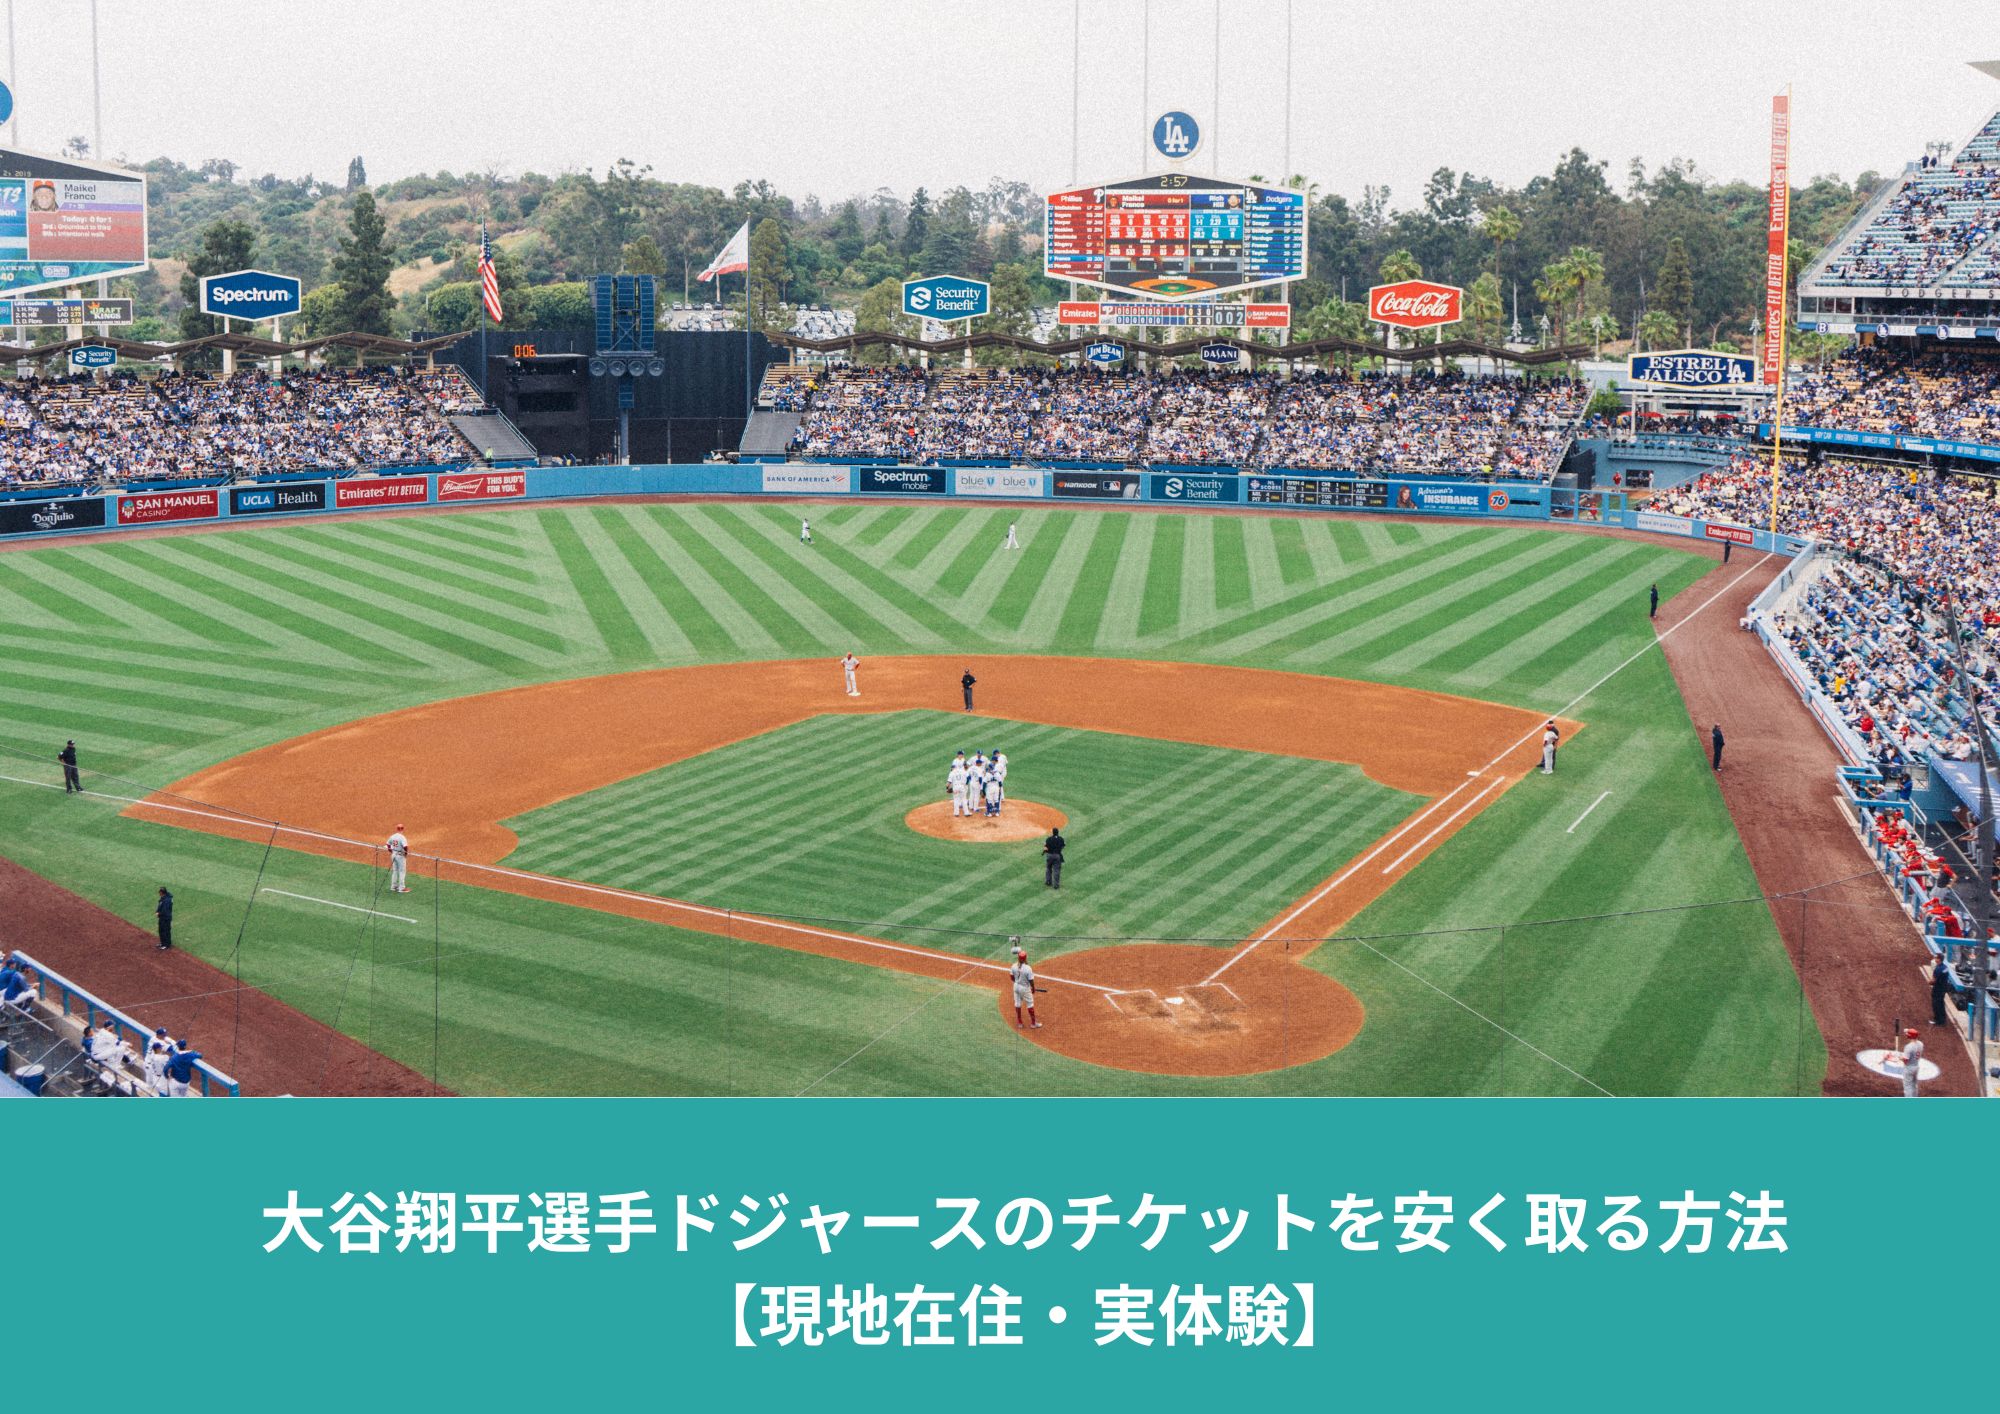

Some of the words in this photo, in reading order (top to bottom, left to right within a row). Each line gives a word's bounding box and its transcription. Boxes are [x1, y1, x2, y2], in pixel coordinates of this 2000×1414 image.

[1163, 116, 1188, 153] LA
[1773, 112, 1787, 145] BETTER
[1773, 146, 1786, 167] FLY
[1160, 176, 1188, 187] 2:57
[64, 184, 96, 192] Maikel
[64, 192, 96, 200] Franco
[1266, 196, 1293, 204] Dodgers
[1770, 167, 1786, 232] Emirates
[1768, 254, 1783, 287] BETTER
[212, 286, 288, 306] Spectrum
[936, 287, 980, 300] Security
[1767, 288, 1782, 304] FLY
[936, 300, 975, 310] Benefit
[1376, 292, 1454, 317] Coca-Cola
[1216, 312, 1222, 324] 0
[1226, 312, 1233, 324] 0
[1236, 312, 1243, 324] 2
[1819, 323, 1826, 333] B
[1765, 306, 1780, 372] Emirates
[514, 345, 536, 357] 0:06
[1089, 347, 1102, 360] JIM
[1102, 344, 1121, 359] BEAM
[1204, 350, 1238, 359] DASANI
[1639, 368, 1722, 383] JALISCO
[1742, 425, 1756, 434] 2:57
[487, 477, 502, 485] THIS
[503, 476, 524, 484] BUD'S
[874, 471, 928, 483] Spectrum
[961, 476, 984, 485] blue
[1003, 477, 1026, 486] blue
[1186, 479, 1223, 490] Security
[339, 488, 386, 500] Emirates
[388, 487, 400, 497] FLY
[400, 485, 424, 496] BETTER
[1186, 490, 1218, 499] Benefit
[1418, 487, 1453, 496] Adriana's
[136, 499, 162, 509] SAN
[164, 495, 214, 507] MANUEL
[242, 495, 271, 506] UCLA
[278, 492, 318, 504] Health
[1424, 495, 1479, 505] INSURANCE
[1492, 496, 1505, 506] 76
[32, 513, 53, 523] Don
[50, 512, 74, 525] Julio
[137, 509, 167, 518] CASINO
[1708, 526, 1732, 537] Emirates
